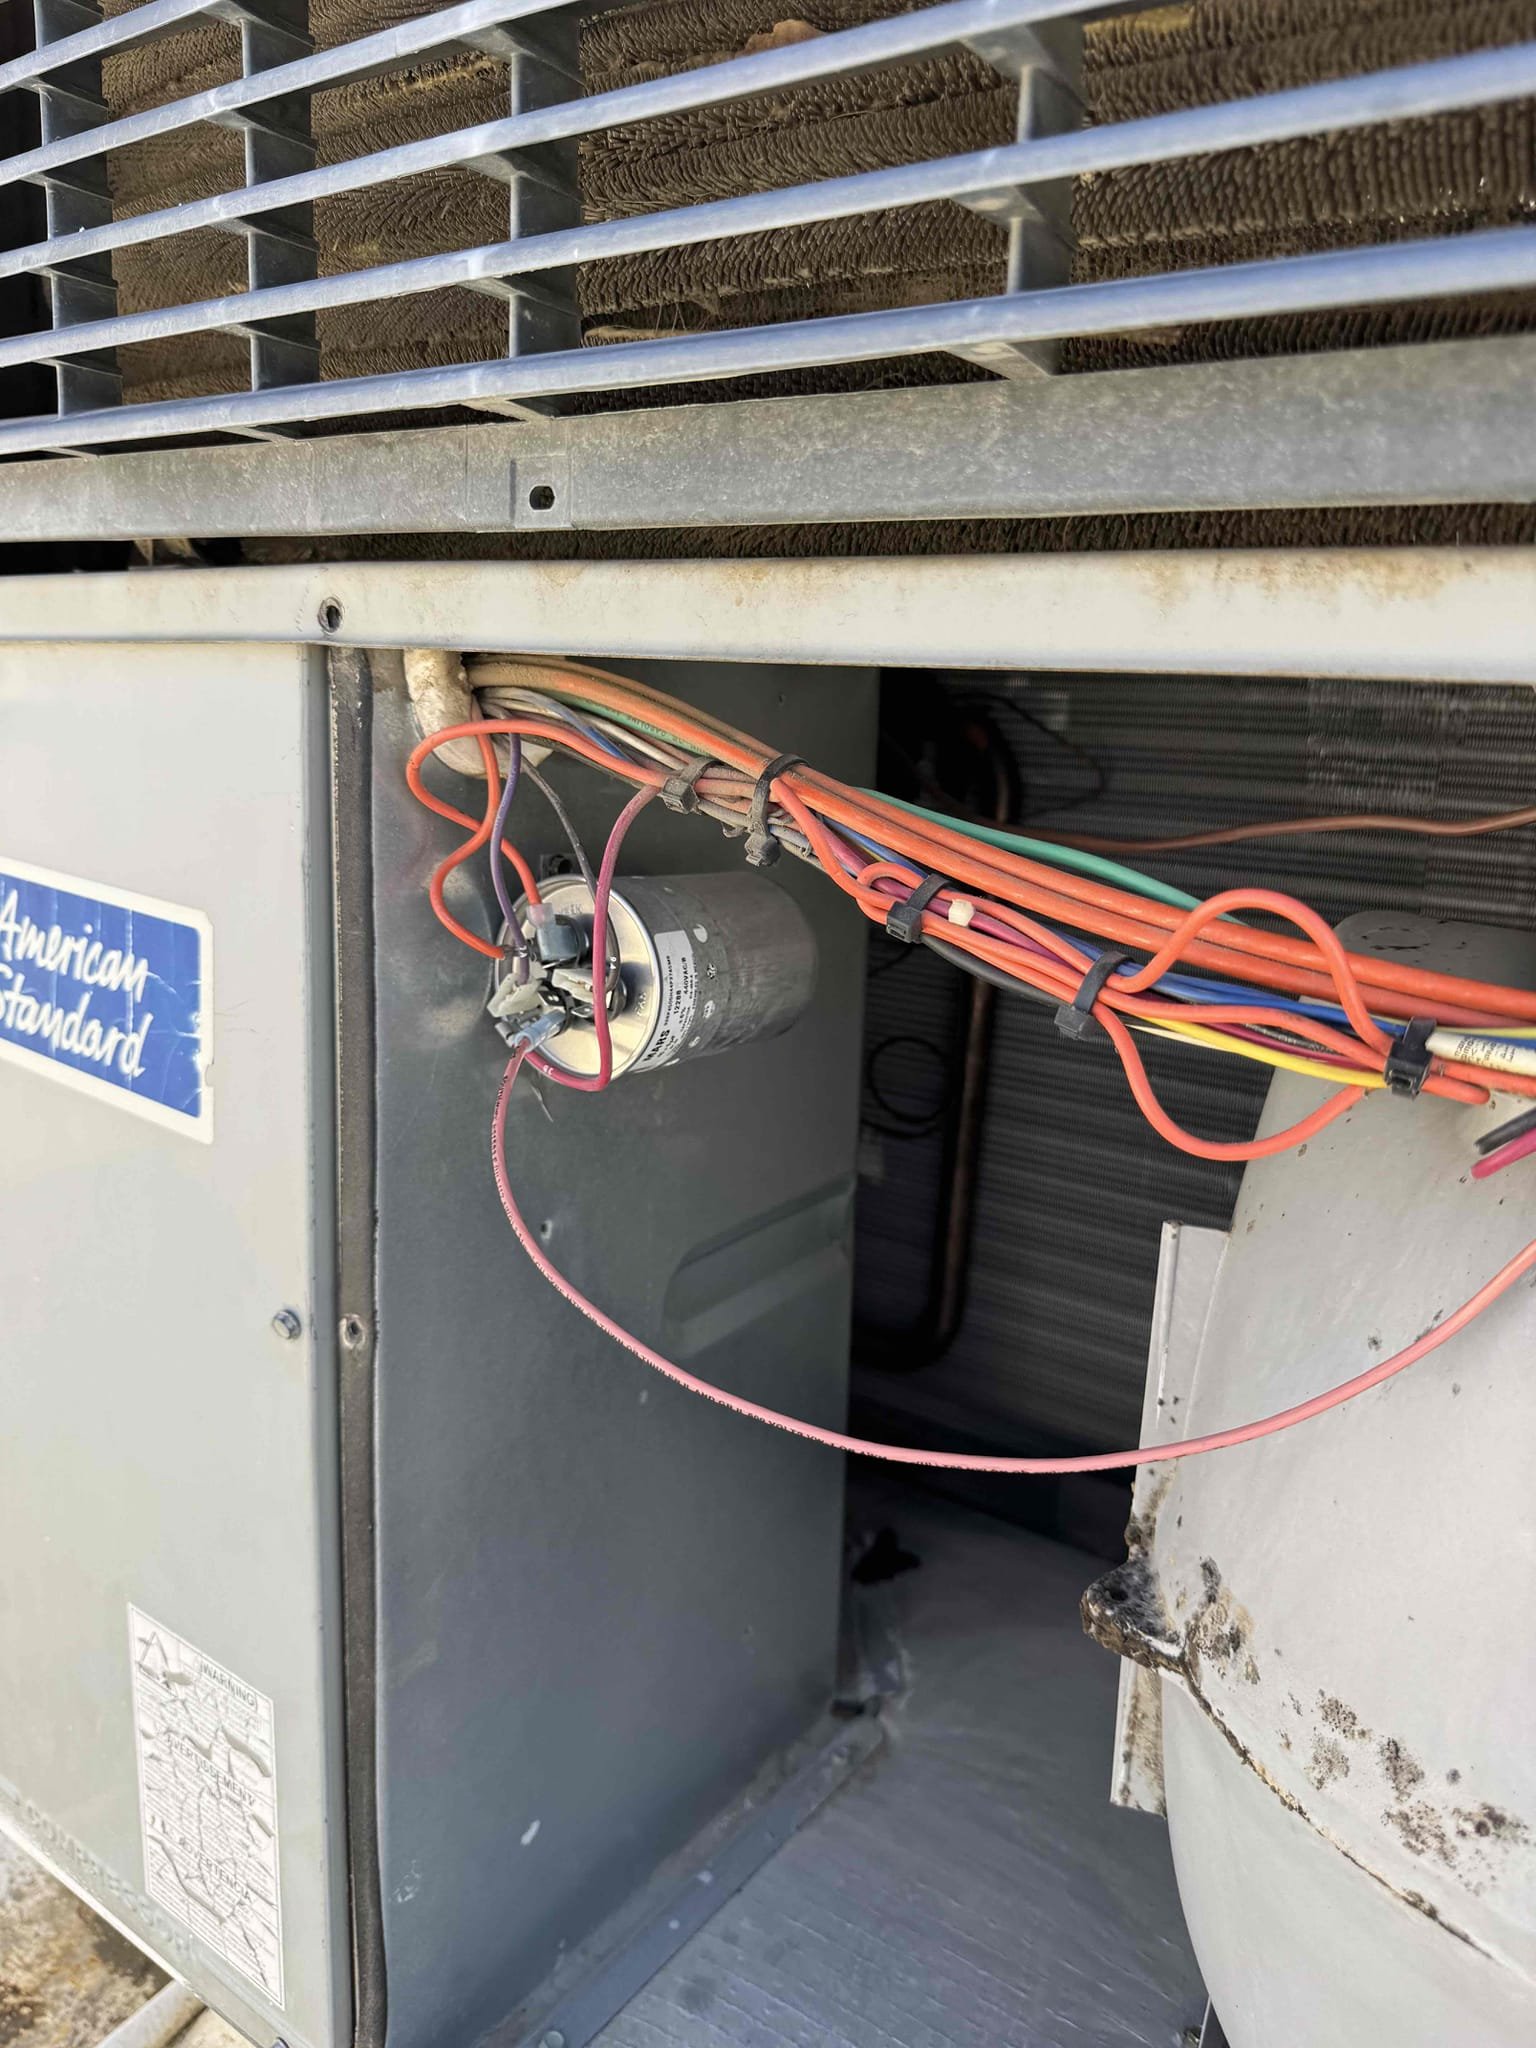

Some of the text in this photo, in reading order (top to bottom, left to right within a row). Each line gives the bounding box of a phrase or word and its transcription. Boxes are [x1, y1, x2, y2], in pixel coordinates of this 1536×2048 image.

[0, 889, 148, 1002] American
[643, 1029, 671, 1062] MARS
[202, 1663, 255, 1707] WARNING
